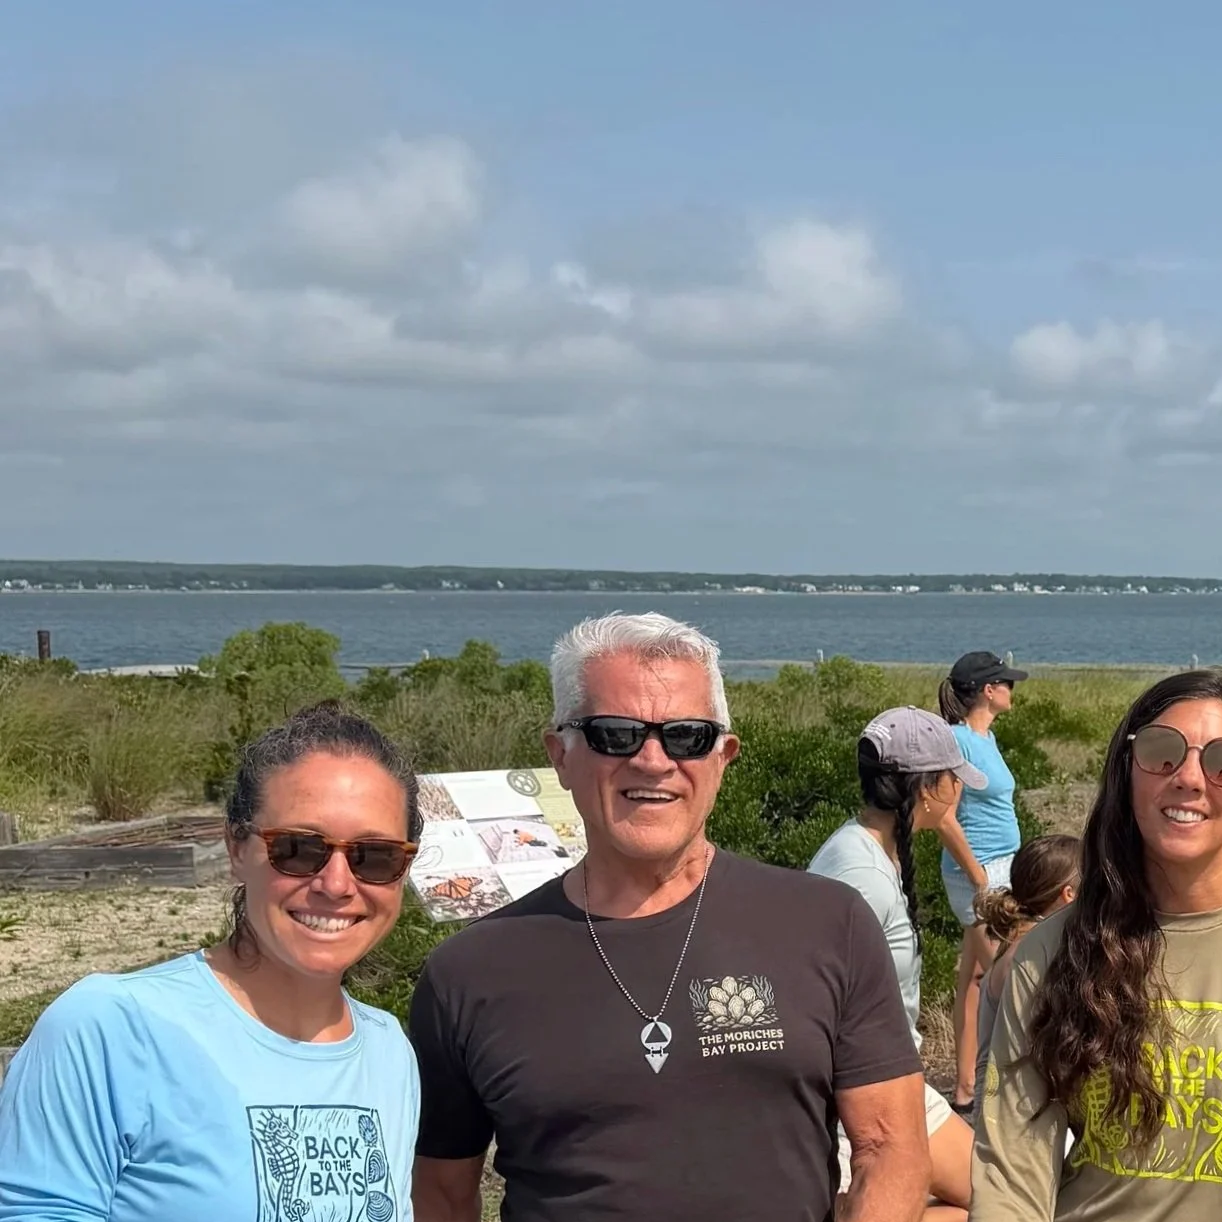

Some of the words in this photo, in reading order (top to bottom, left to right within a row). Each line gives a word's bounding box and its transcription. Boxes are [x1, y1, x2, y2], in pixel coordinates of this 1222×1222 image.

[699, 1034, 723, 1046] THE
[724, 1029, 783, 1042] MORICHES
[702, 1045, 726, 1057] BAY
[730, 1041, 784, 1053] PROJECT
[1172, 1078, 1205, 1097] THE
[304, 1136, 362, 1159] BACK
[318, 1160, 332, 1171] TO
[333, 1160, 351, 1171] THE
[310, 1173, 366, 1196] BAYS
